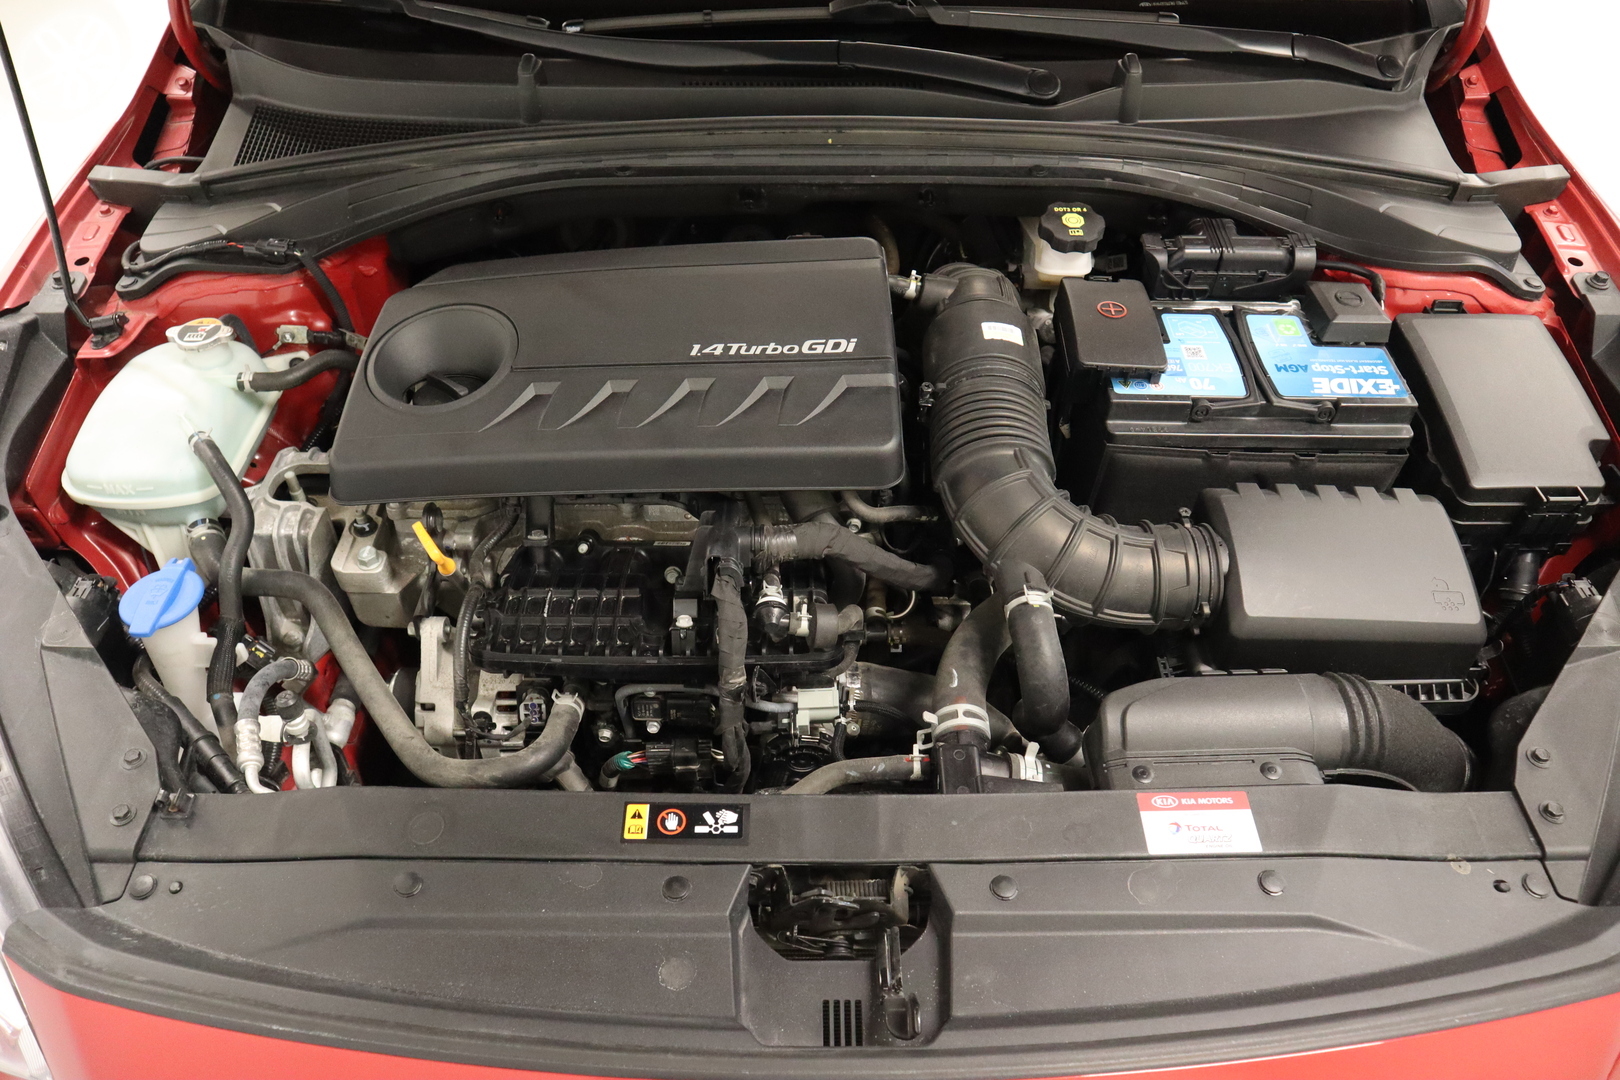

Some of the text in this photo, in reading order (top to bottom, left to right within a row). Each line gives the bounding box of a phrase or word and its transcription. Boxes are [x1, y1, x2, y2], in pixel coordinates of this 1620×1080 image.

[690, 338, 858, 356] 1.4 Turbo GDi
[1188, 362, 1234, 373] EK700
[1274, 364, 1389, 375] Start-Stop AGM
[1189, 378, 1216, 391] 70
[1313, 377, 1400, 395] EXIDE
[103, 483, 136, 495] MAX
[1197, 797, 1234, 805] MOTORS
[1184, 824, 1224, 832] TOTAL
[1188, 834, 1233, 844] QUARTZ
